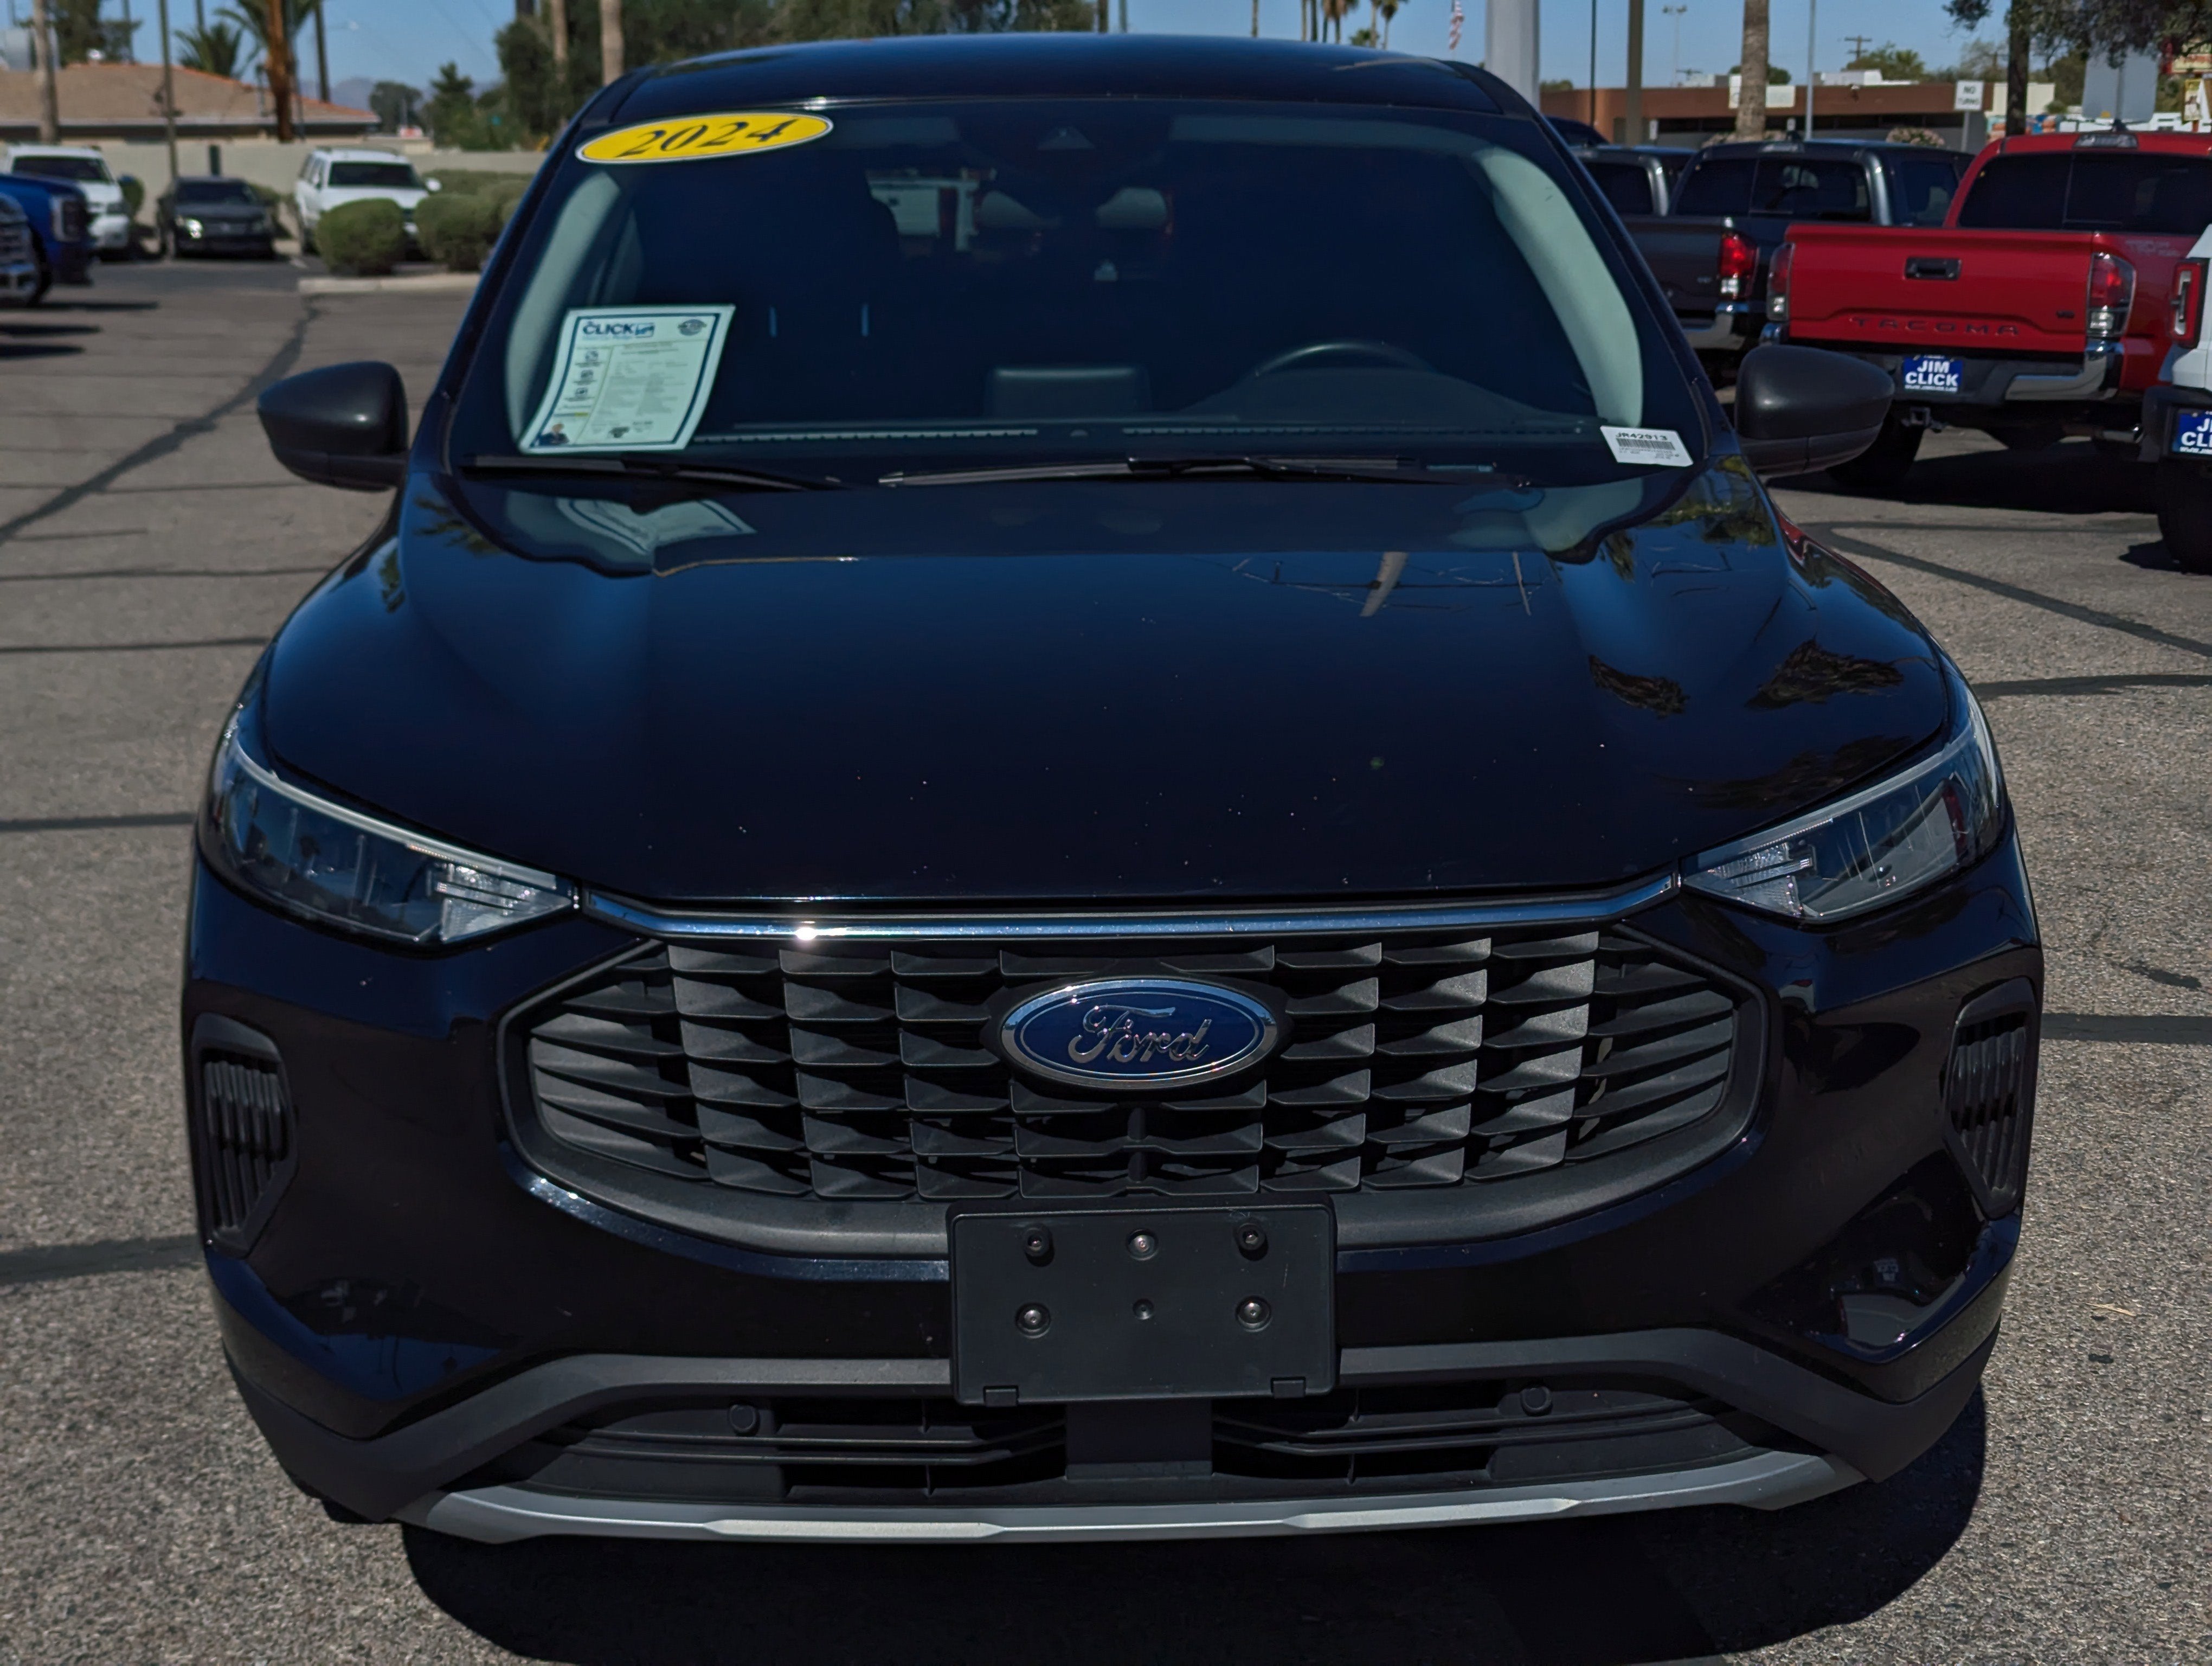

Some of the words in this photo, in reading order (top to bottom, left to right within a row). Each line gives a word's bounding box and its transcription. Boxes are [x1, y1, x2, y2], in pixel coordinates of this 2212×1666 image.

[614, 118, 799, 158] 2024
[583, 323, 633, 335] CLICK
[1849, 317, 2019, 336] TACOMA
[1917, 360, 1950, 374] JIM
[1905, 371, 1959, 386] CLICK
[1068, 1004, 1212, 1063] Ford
